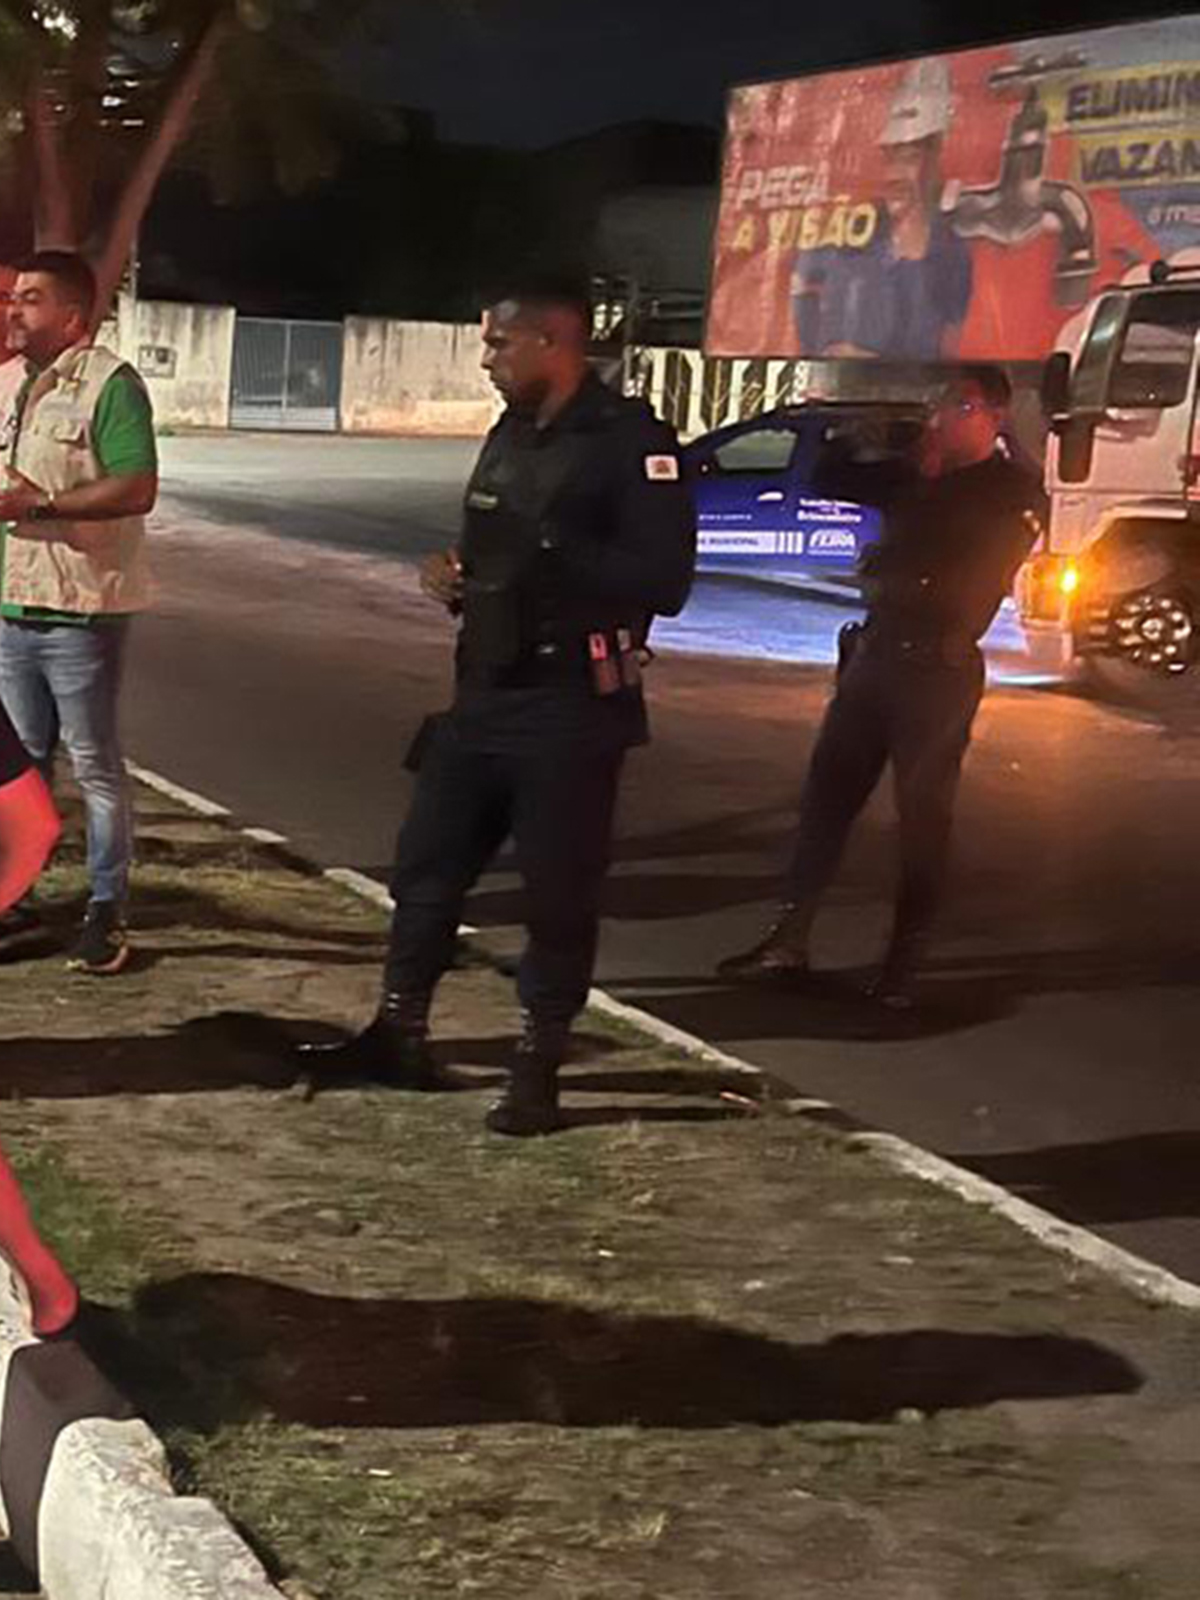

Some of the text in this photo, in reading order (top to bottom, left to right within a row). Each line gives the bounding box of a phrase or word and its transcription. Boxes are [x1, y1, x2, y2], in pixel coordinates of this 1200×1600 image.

[736, 162, 830, 209] PEGA
[731, 194, 878, 251] A VISÃO
